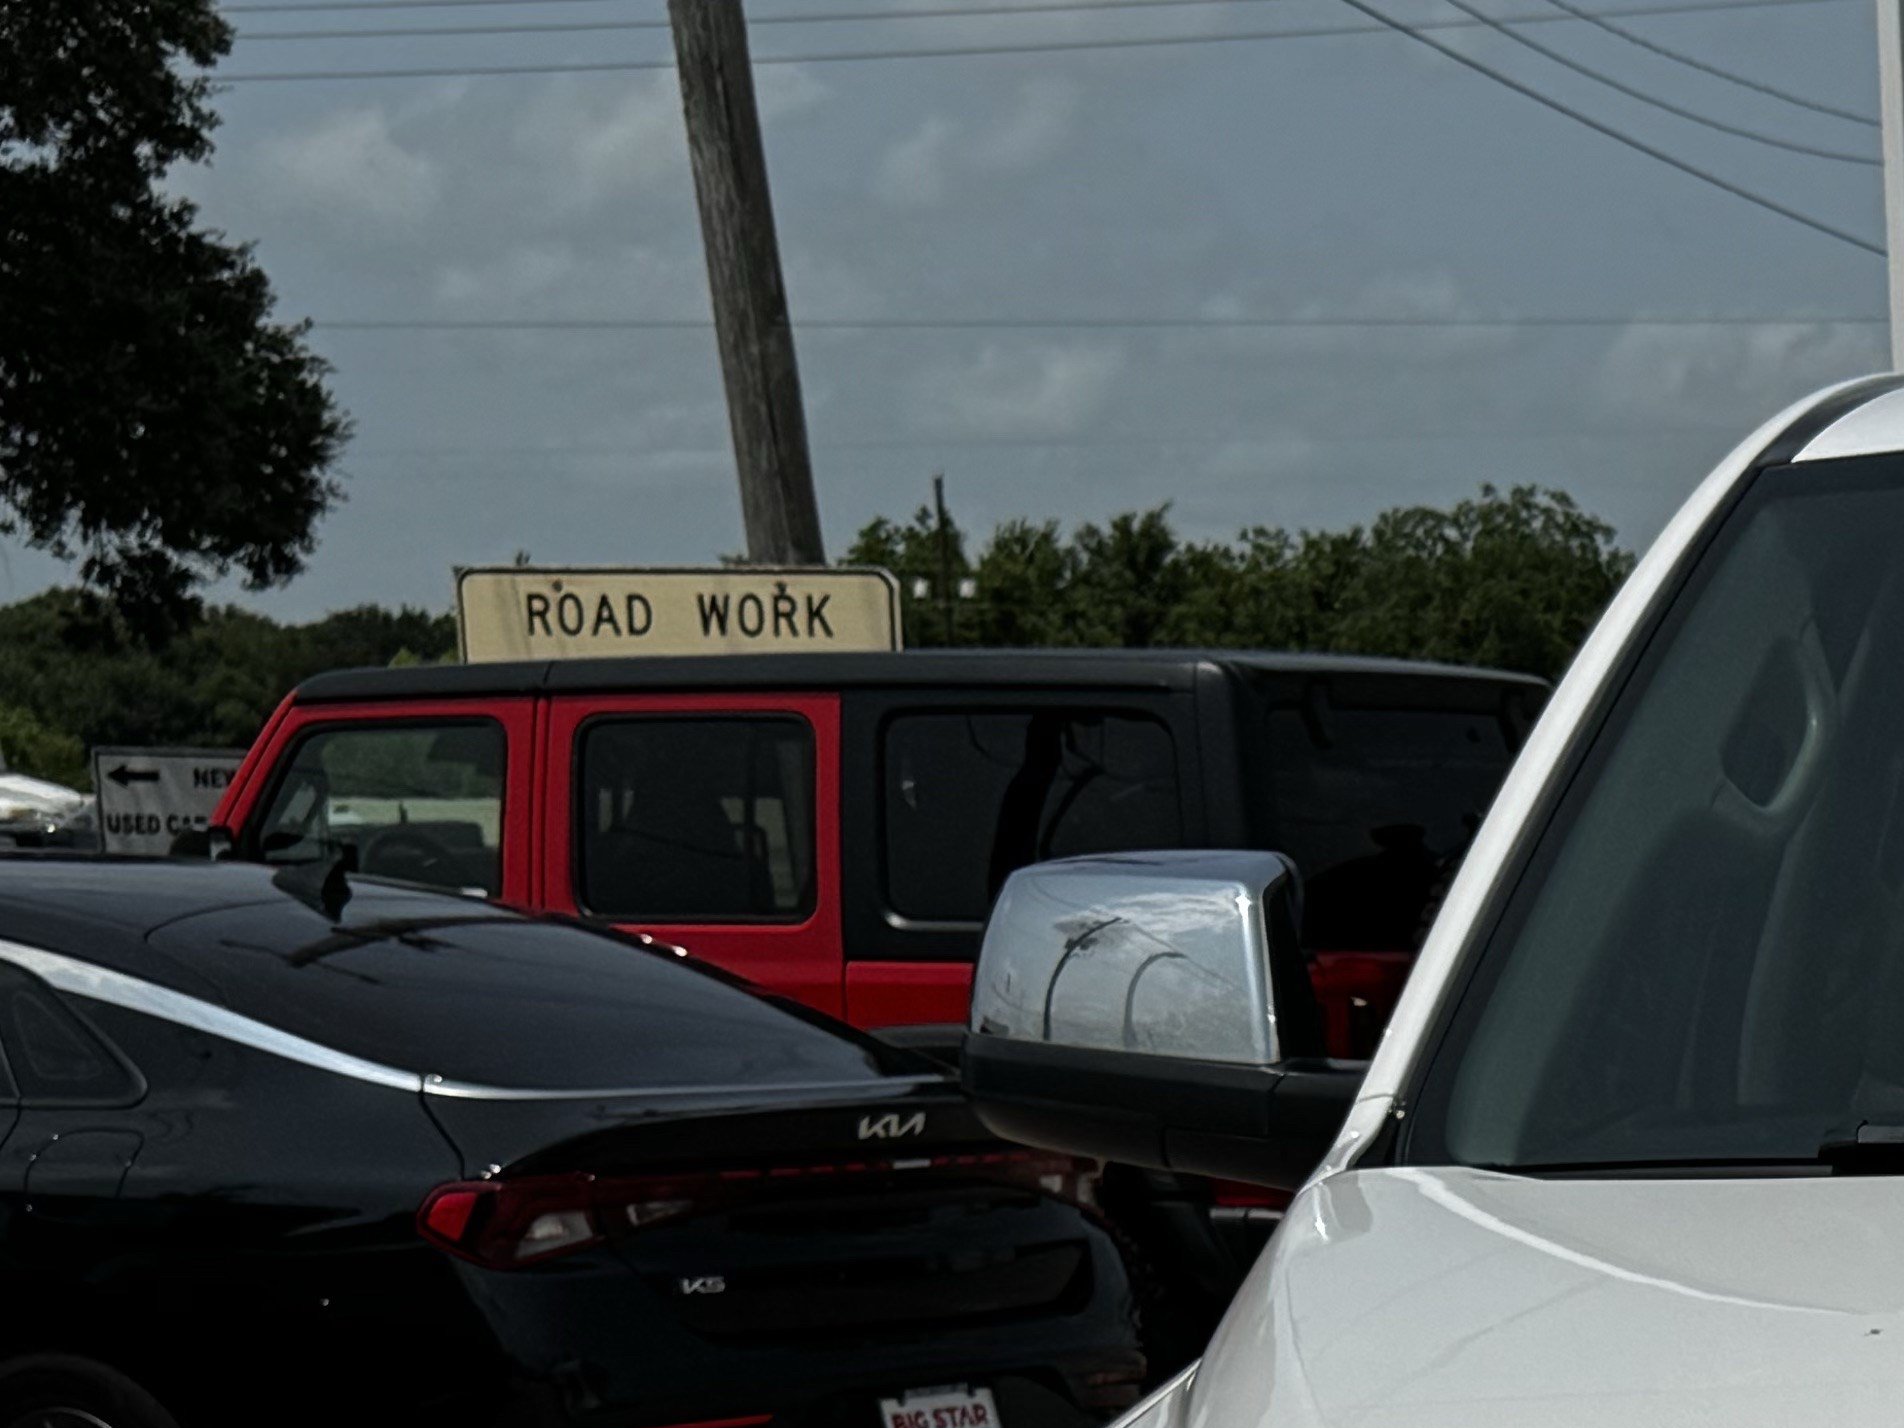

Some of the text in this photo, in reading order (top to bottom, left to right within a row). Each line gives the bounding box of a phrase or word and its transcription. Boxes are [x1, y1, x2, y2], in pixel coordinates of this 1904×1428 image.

[526, 591, 836, 638] ROAD WORK
[107, 814, 161, 835] USED
[857, 1112, 927, 1140] KIA
[682, 1276, 726, 1295] K5
